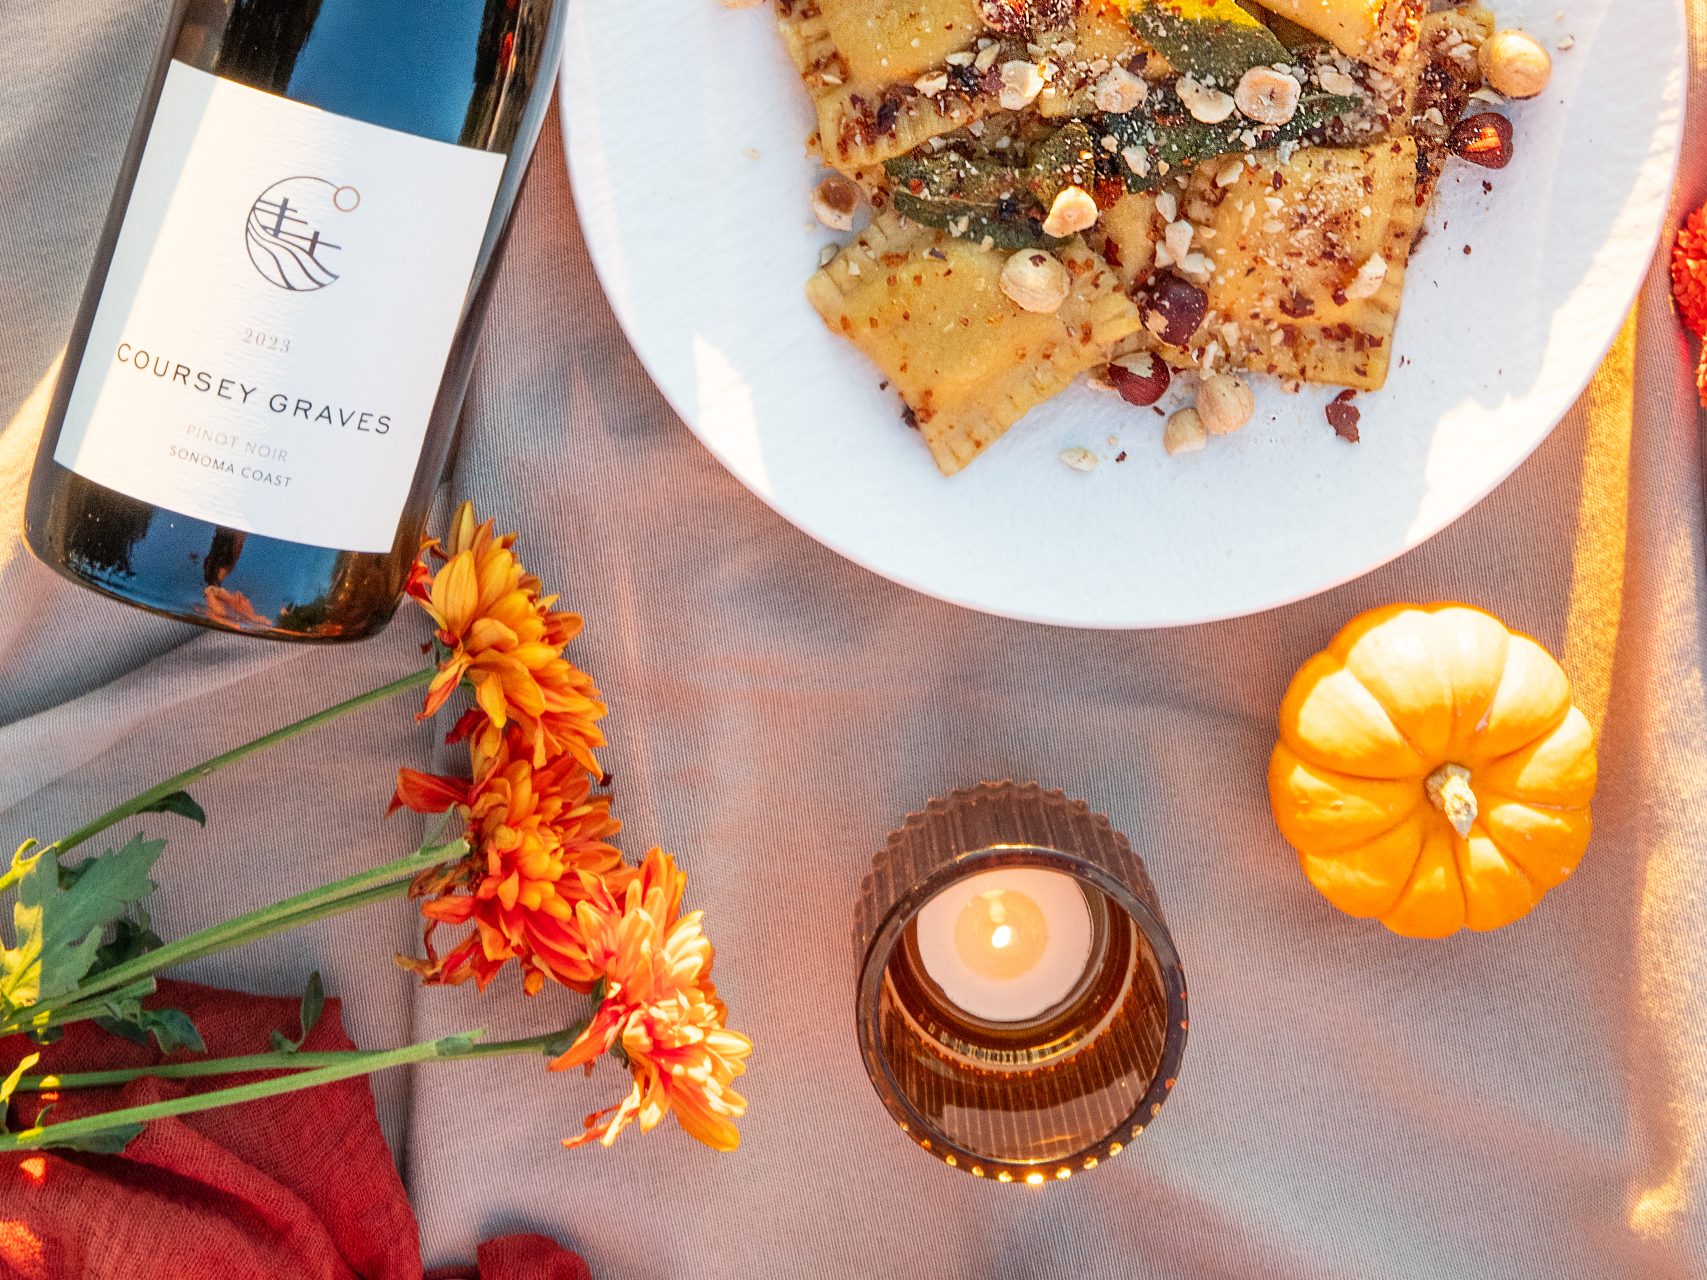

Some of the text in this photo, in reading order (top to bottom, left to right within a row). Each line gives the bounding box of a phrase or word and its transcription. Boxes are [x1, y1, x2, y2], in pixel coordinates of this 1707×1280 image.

[242, 326, 292, 354] 2023
[116, 342, 393, 436] COURSEY GRAVES
[186, 423, 289, 463] PINOT NOIR
[169, 445, 294, 489] SONOMA COAST
